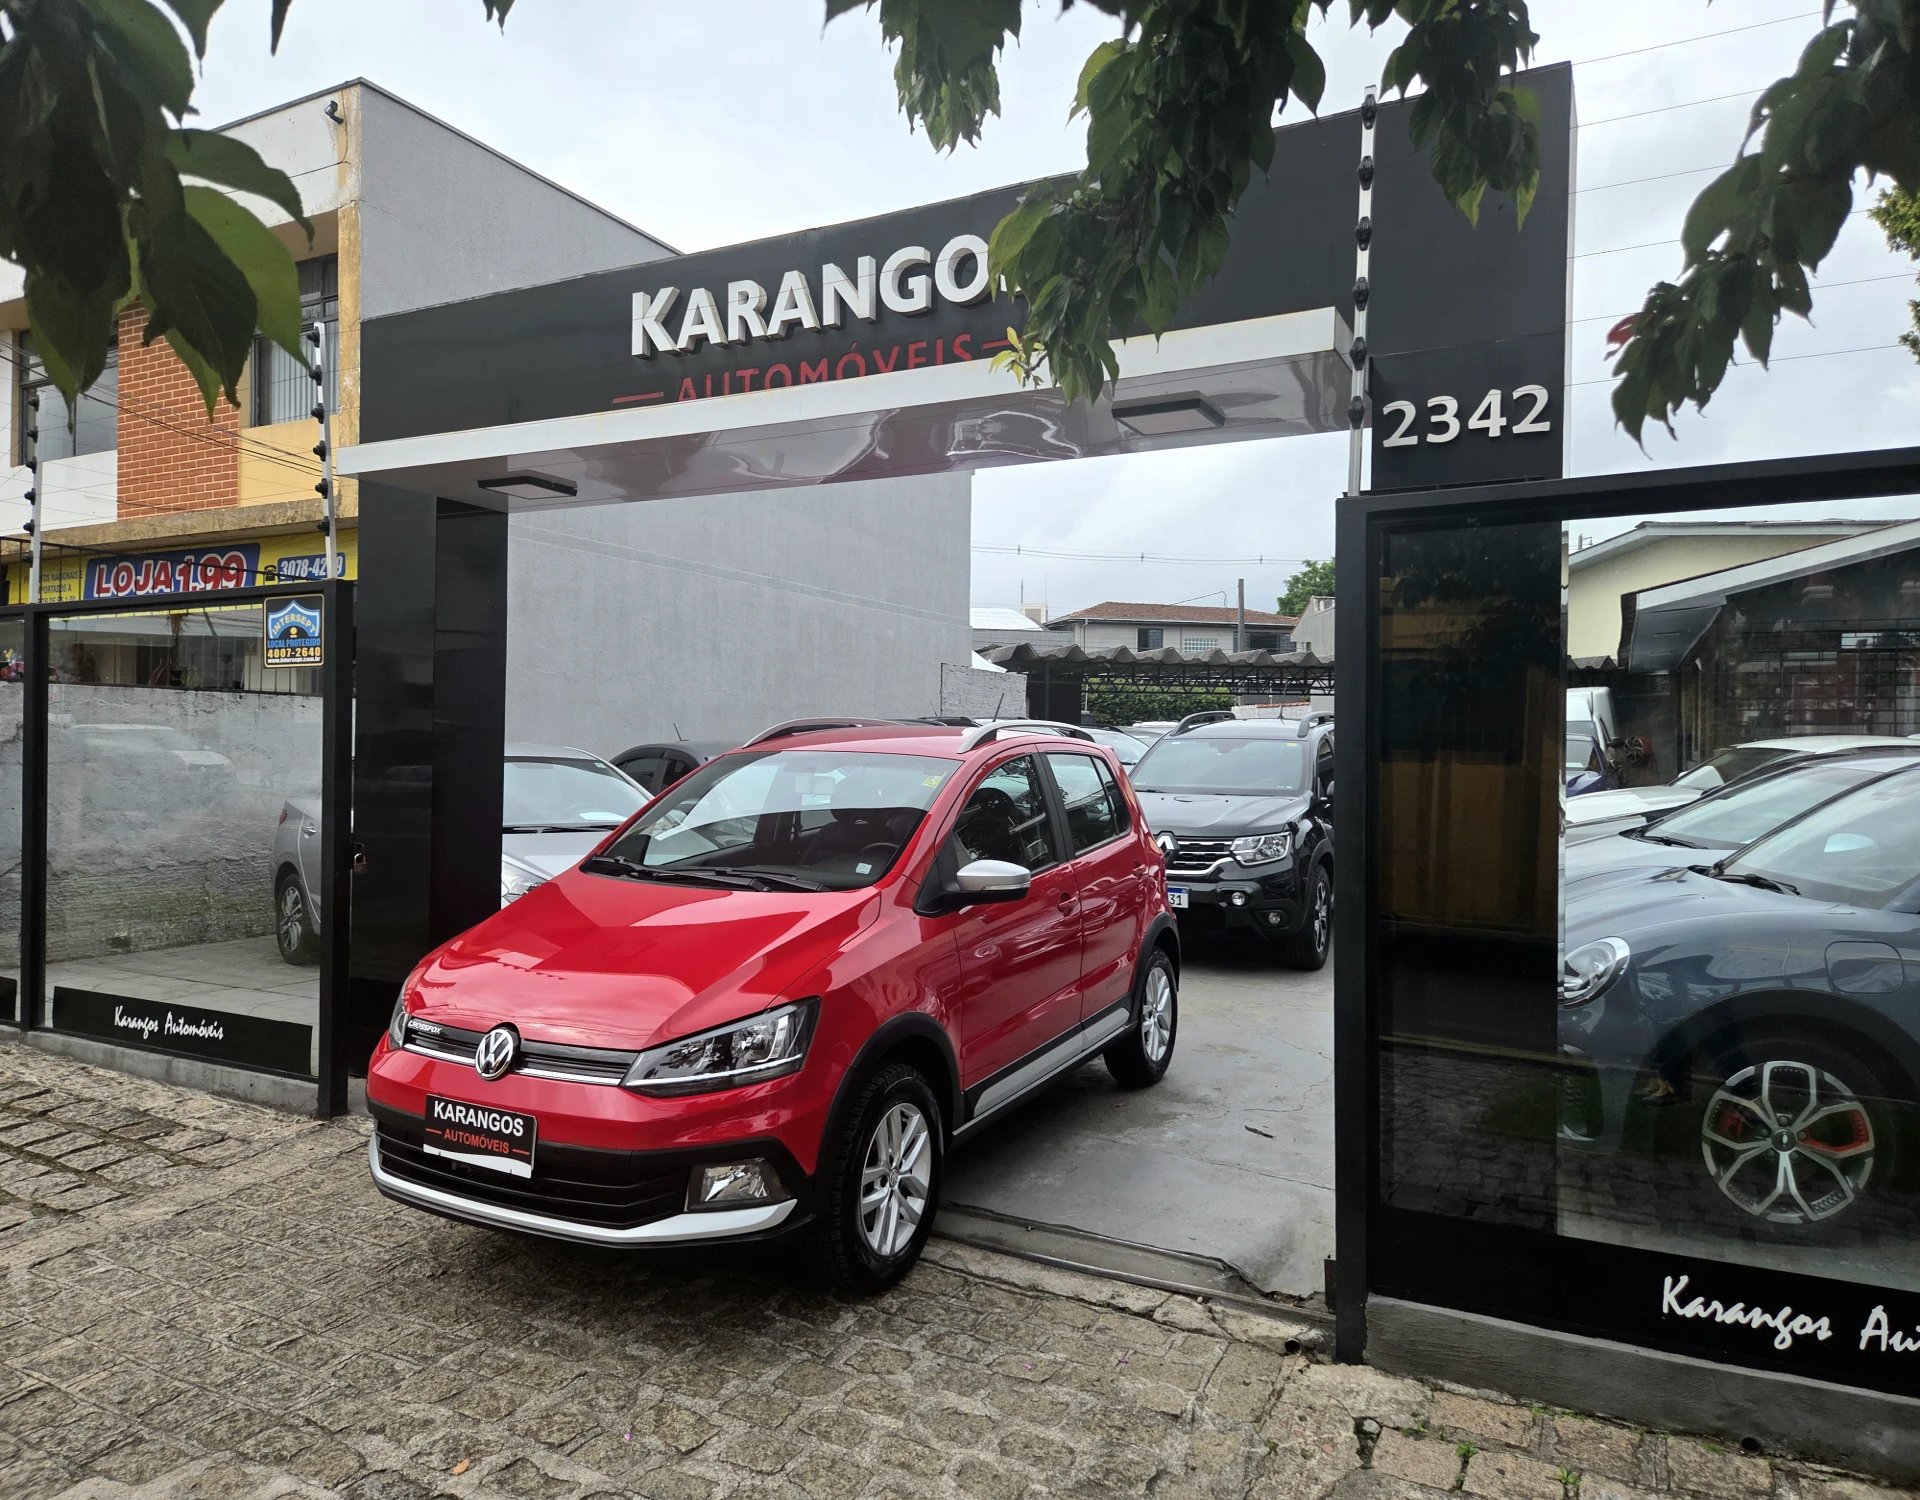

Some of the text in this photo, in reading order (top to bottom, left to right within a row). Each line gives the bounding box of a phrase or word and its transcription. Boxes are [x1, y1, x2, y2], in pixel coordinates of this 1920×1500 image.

[631, 234, 1021, 358] KARANGO
[677, 333, 972, 402] AUTOMÓVEIS
[1382, 384, 1551, 448] 2342
[94, 560, 174, 598] LOJA
[280, 556, 344, 579] 3078-429
[272, 613, 317, 635] INTERSEPT
[267, 647, 321, 658] 4007-2640
[268, 637, 321, 648] LOCAL PROTEGIDO
[114, 1005, 159, 1039] Karangos
[407, 1020, 443, 1034] CROSSFOX
[434, 1101, 524, 1137] KARANGOS
[444, 1128, 510, 1154] AUTOMÓVEIS
[1662, 1275, 1920, 1352] Karangos Au
